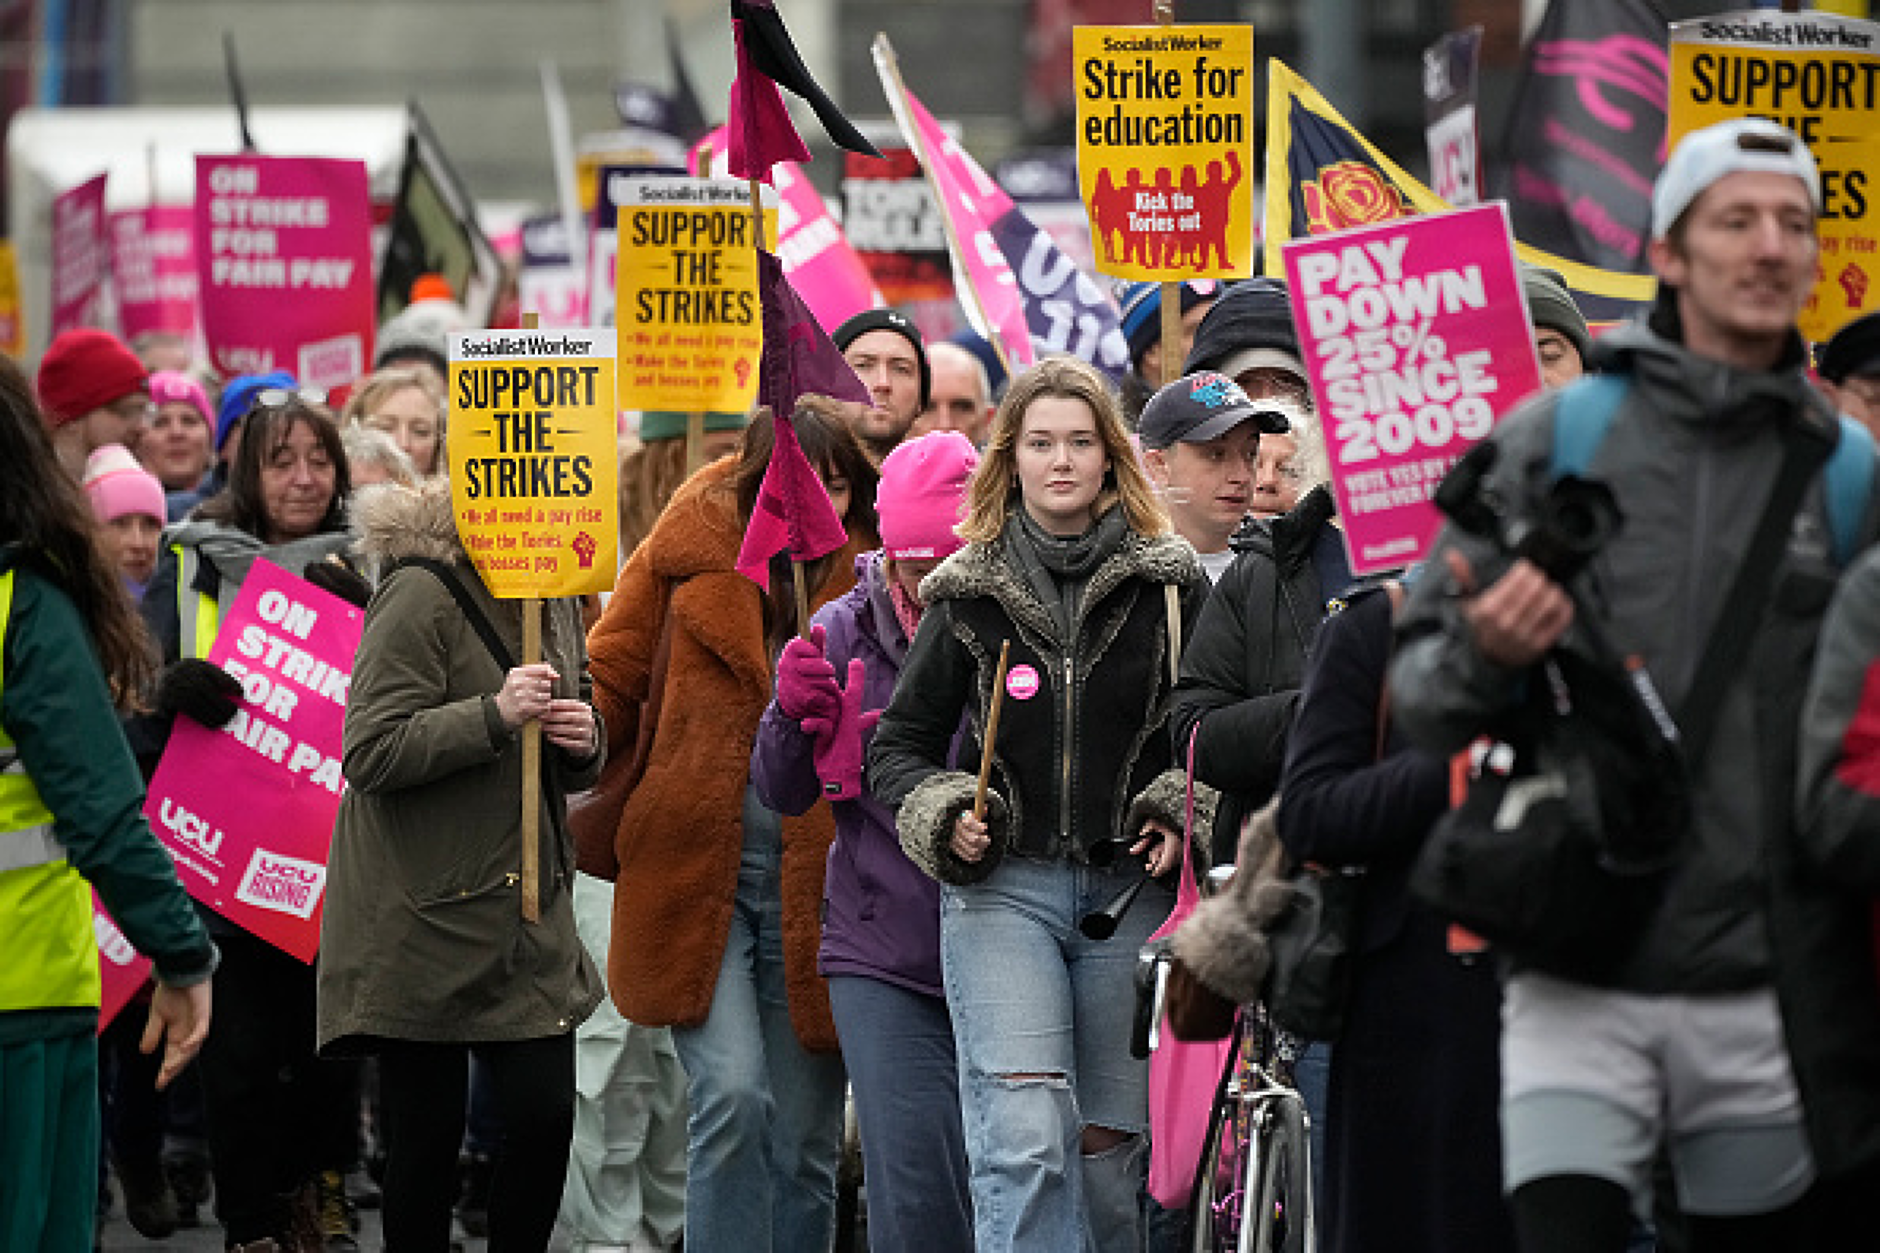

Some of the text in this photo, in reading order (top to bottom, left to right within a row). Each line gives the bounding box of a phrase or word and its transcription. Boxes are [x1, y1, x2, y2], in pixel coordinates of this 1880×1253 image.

[1104, 35, 1223, 51] Socialist Worker
[1702, 22, 1873, 48] Socialist Worker
[1085, 56, 1244, 98] Strike for
[1690, 54, 1880, 110] SUPPORT
[1085, 104, 1242, 145] education
[209, 166, 259, 194] ON
[639, 185, 704, 200] Socialist
[210, 197, 330, 227] STRIKE
[1135, 192, 1194, 211] Kick the
[1127, 211, 1200, 231] Tories out
[211, 228, 277, 255] FOR
[211, 258, 286, 288] FAIR
[291, 259, 355, 288] PAY
[671, 250, 722, 285] THE
[1298, 237, 1409, 296] PAY
[636, 288, 753, 325] STRIKES
[1306, 265, 1488, 340] DOWN
[461, 336, 593, 355] Socialist Worker
[1316, 318, 1447, 382] 25%
[458, 366, 599, 409] SUPPORT
[1327, 349, 1499, 420] SINCE
[493, 412, 554, 453] THE
[1335, 398, 1495, 465] 2009
[465, 456, 592, 498] STRIKES
[502, 506, 532, 524] need
[549, 509, 573, 527] pay
[576, 506, 602, 523] rise
[497, 532, 516, 550] the
[522, 531, 563, 548] Tories
[534, 556, 558, 574] pay
[257, 589, 318, 641] ON
[236, 625, 351, 707] STRIK
[224, 708, 343, 796] AIR PA
[159, 796, 225, 857] UCU
[258, 856, 318, 884] UCU
